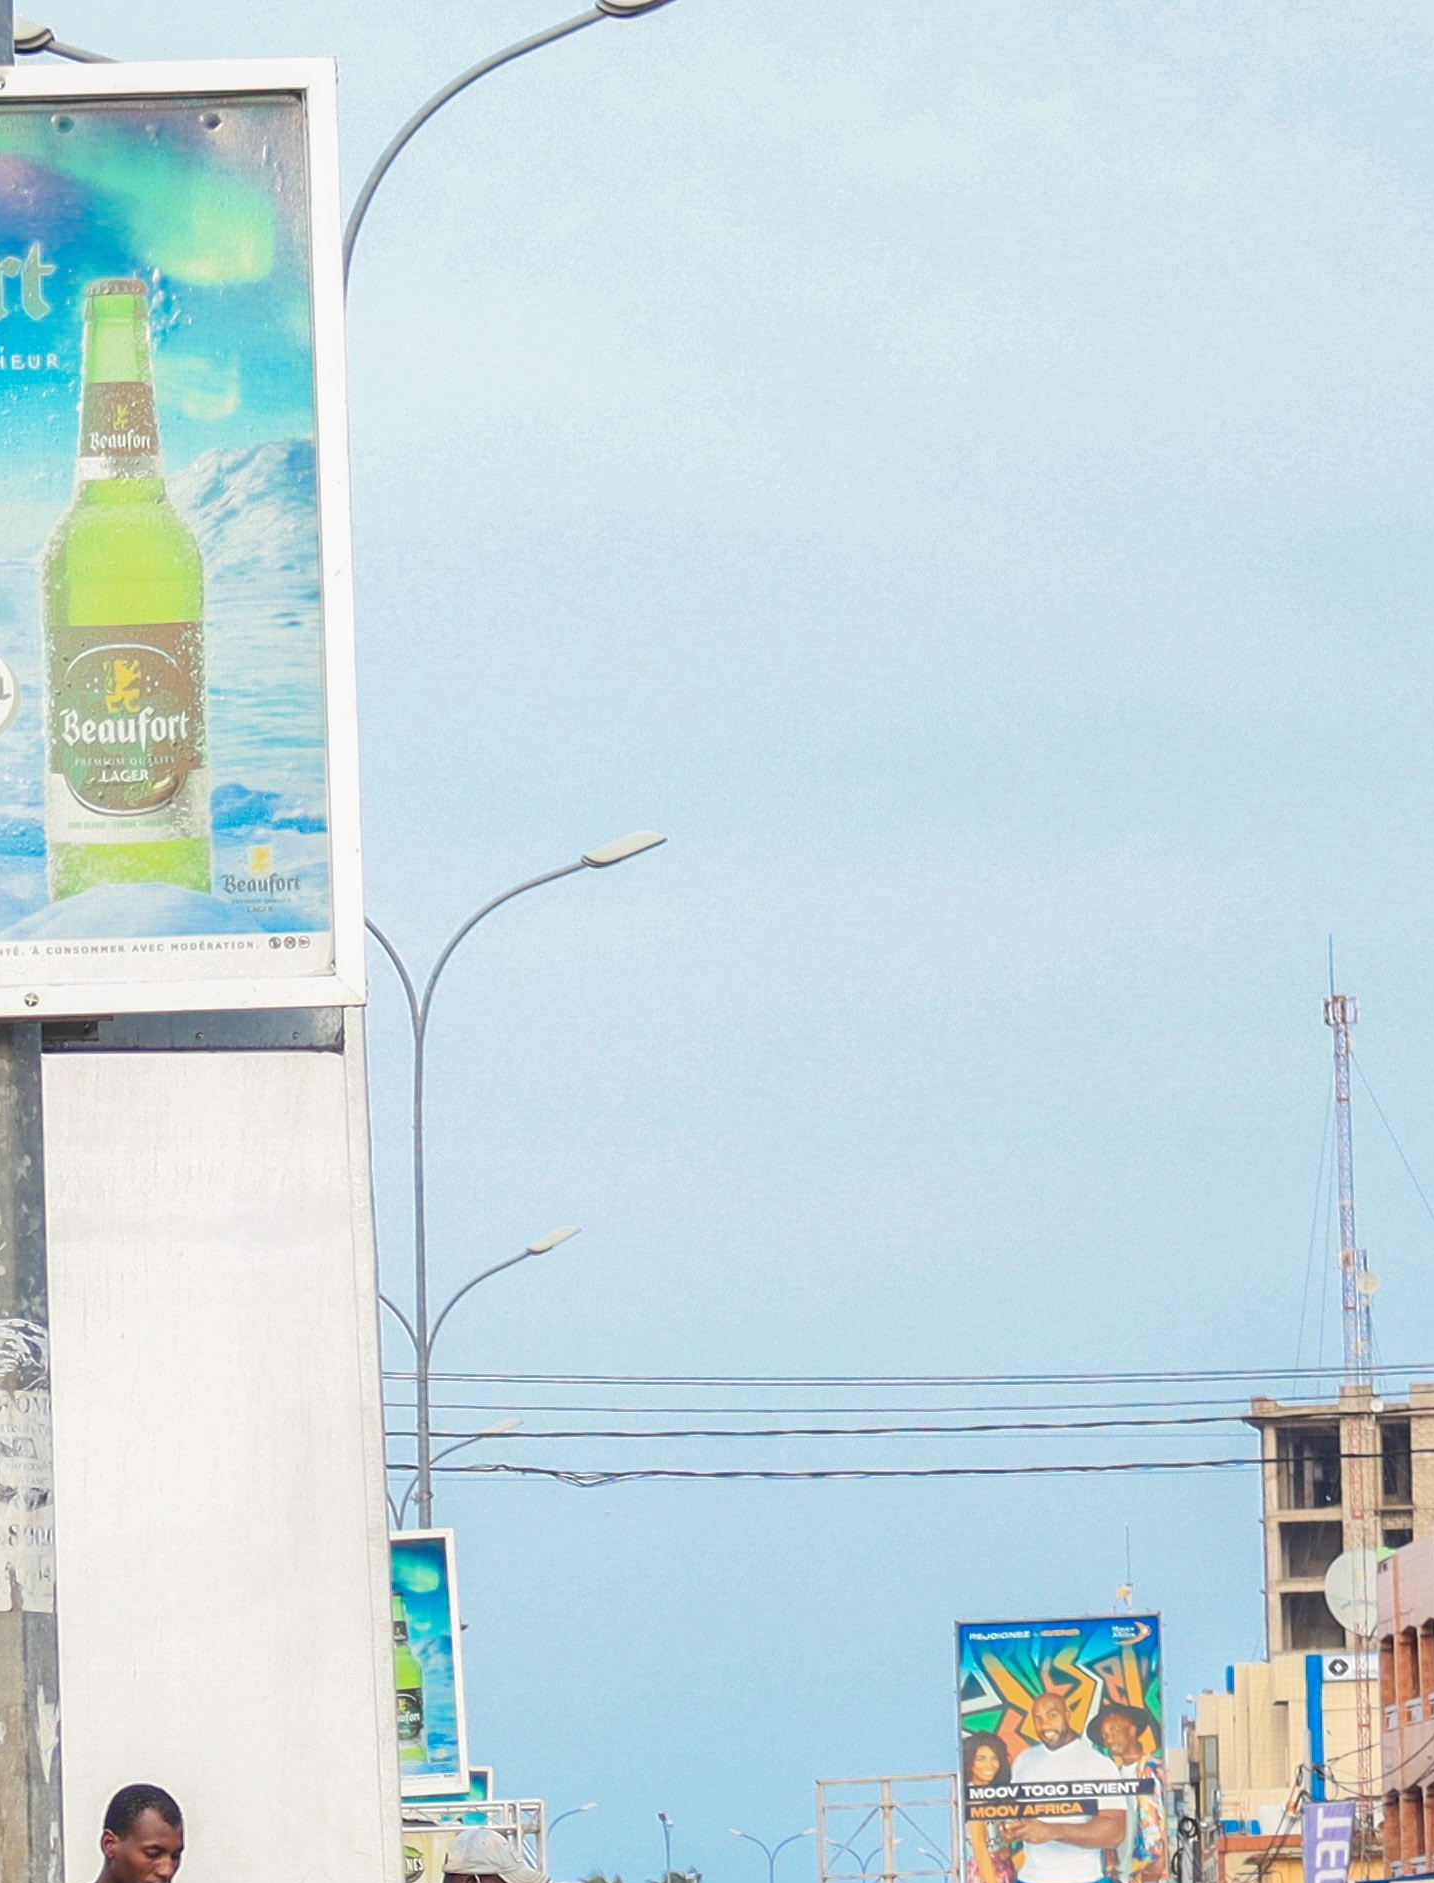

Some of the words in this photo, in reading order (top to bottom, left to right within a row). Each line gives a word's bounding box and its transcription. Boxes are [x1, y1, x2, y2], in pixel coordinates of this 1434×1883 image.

[89, 430, 152, 453] Beaufort
[60, 706, 189, 752] Beaufort
[99, 769, 150, 783] LAGER
[221, 873, 301, 895] Beaufort
[45, 945, 126, 956] CONSOMMER
[131, 943, 165, 953] AVEC
[968, 1786, 1019, 1800] MOOV
[1022, 1783, 1069, 1797] TOGO
[1071, 1781, 1140, 1795] DEVIENT
[969, 1805, 1020, 1818] MOOV
[1022, 1802, 1084, 1816] AFRICA
